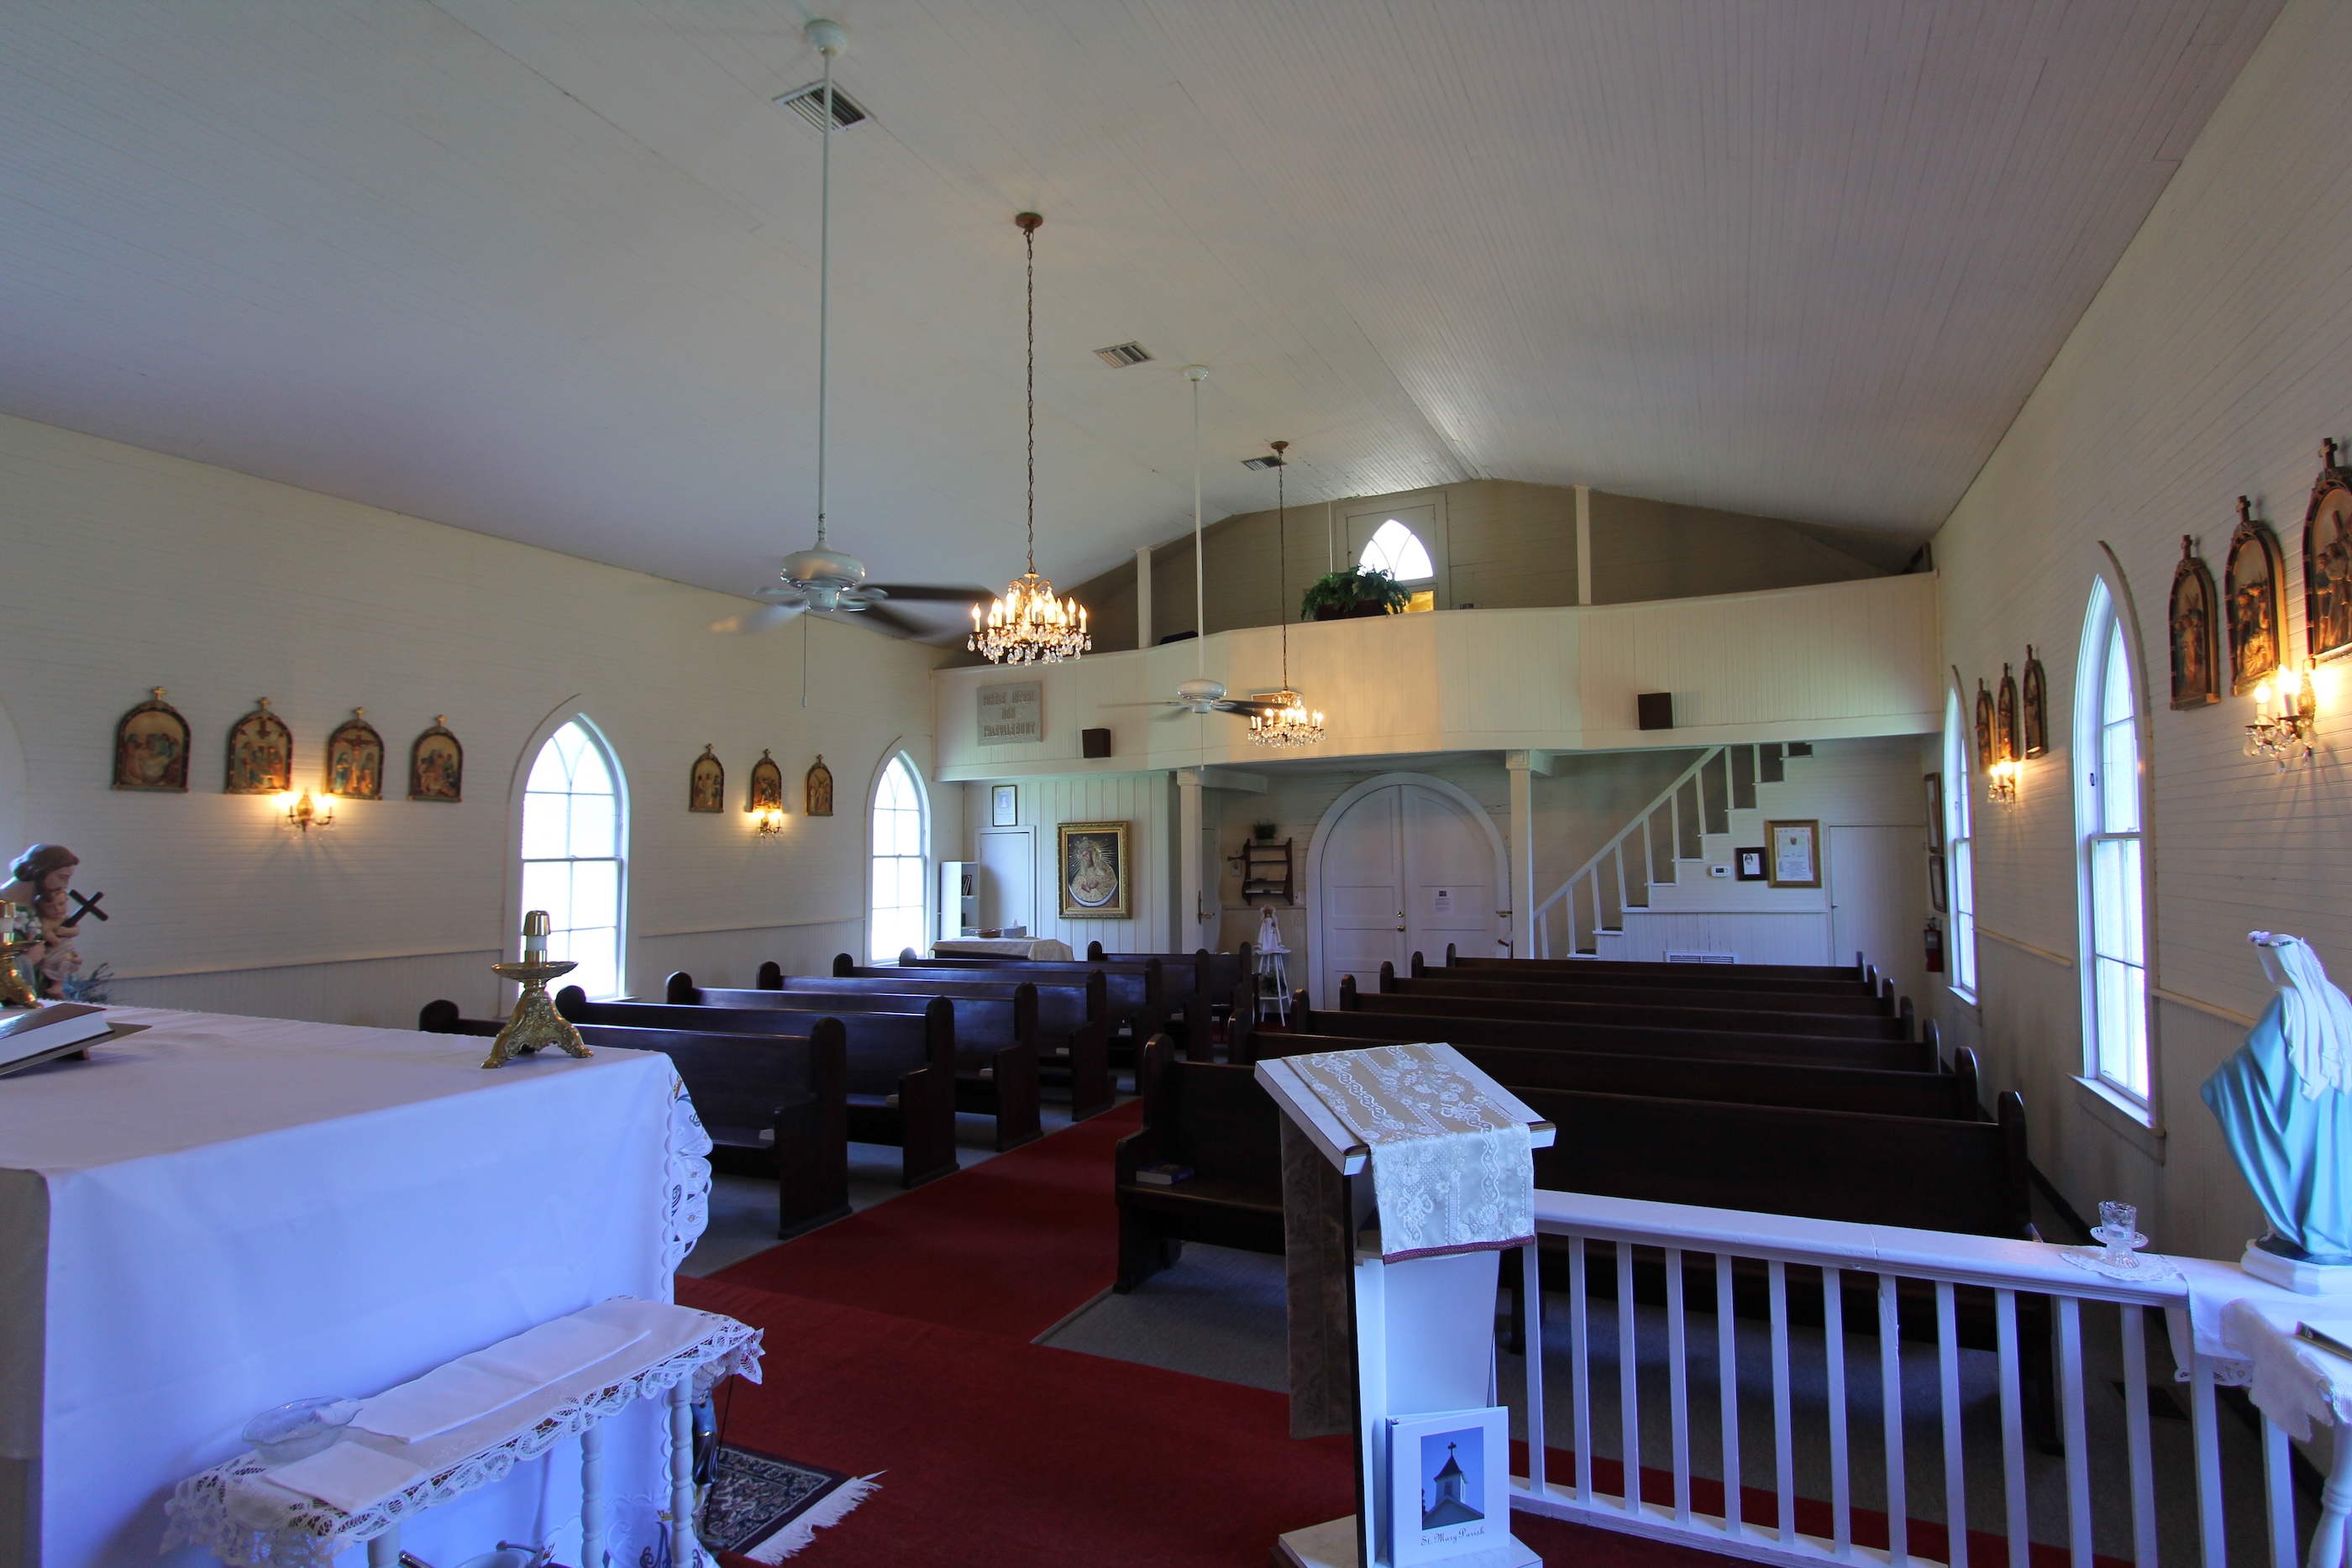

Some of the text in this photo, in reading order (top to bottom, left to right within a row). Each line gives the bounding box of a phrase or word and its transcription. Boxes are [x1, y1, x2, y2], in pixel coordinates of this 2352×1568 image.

[1001, 706, 1016, 720] NON
[1420, 1525, 1484, 1546] St. Mary Parish
